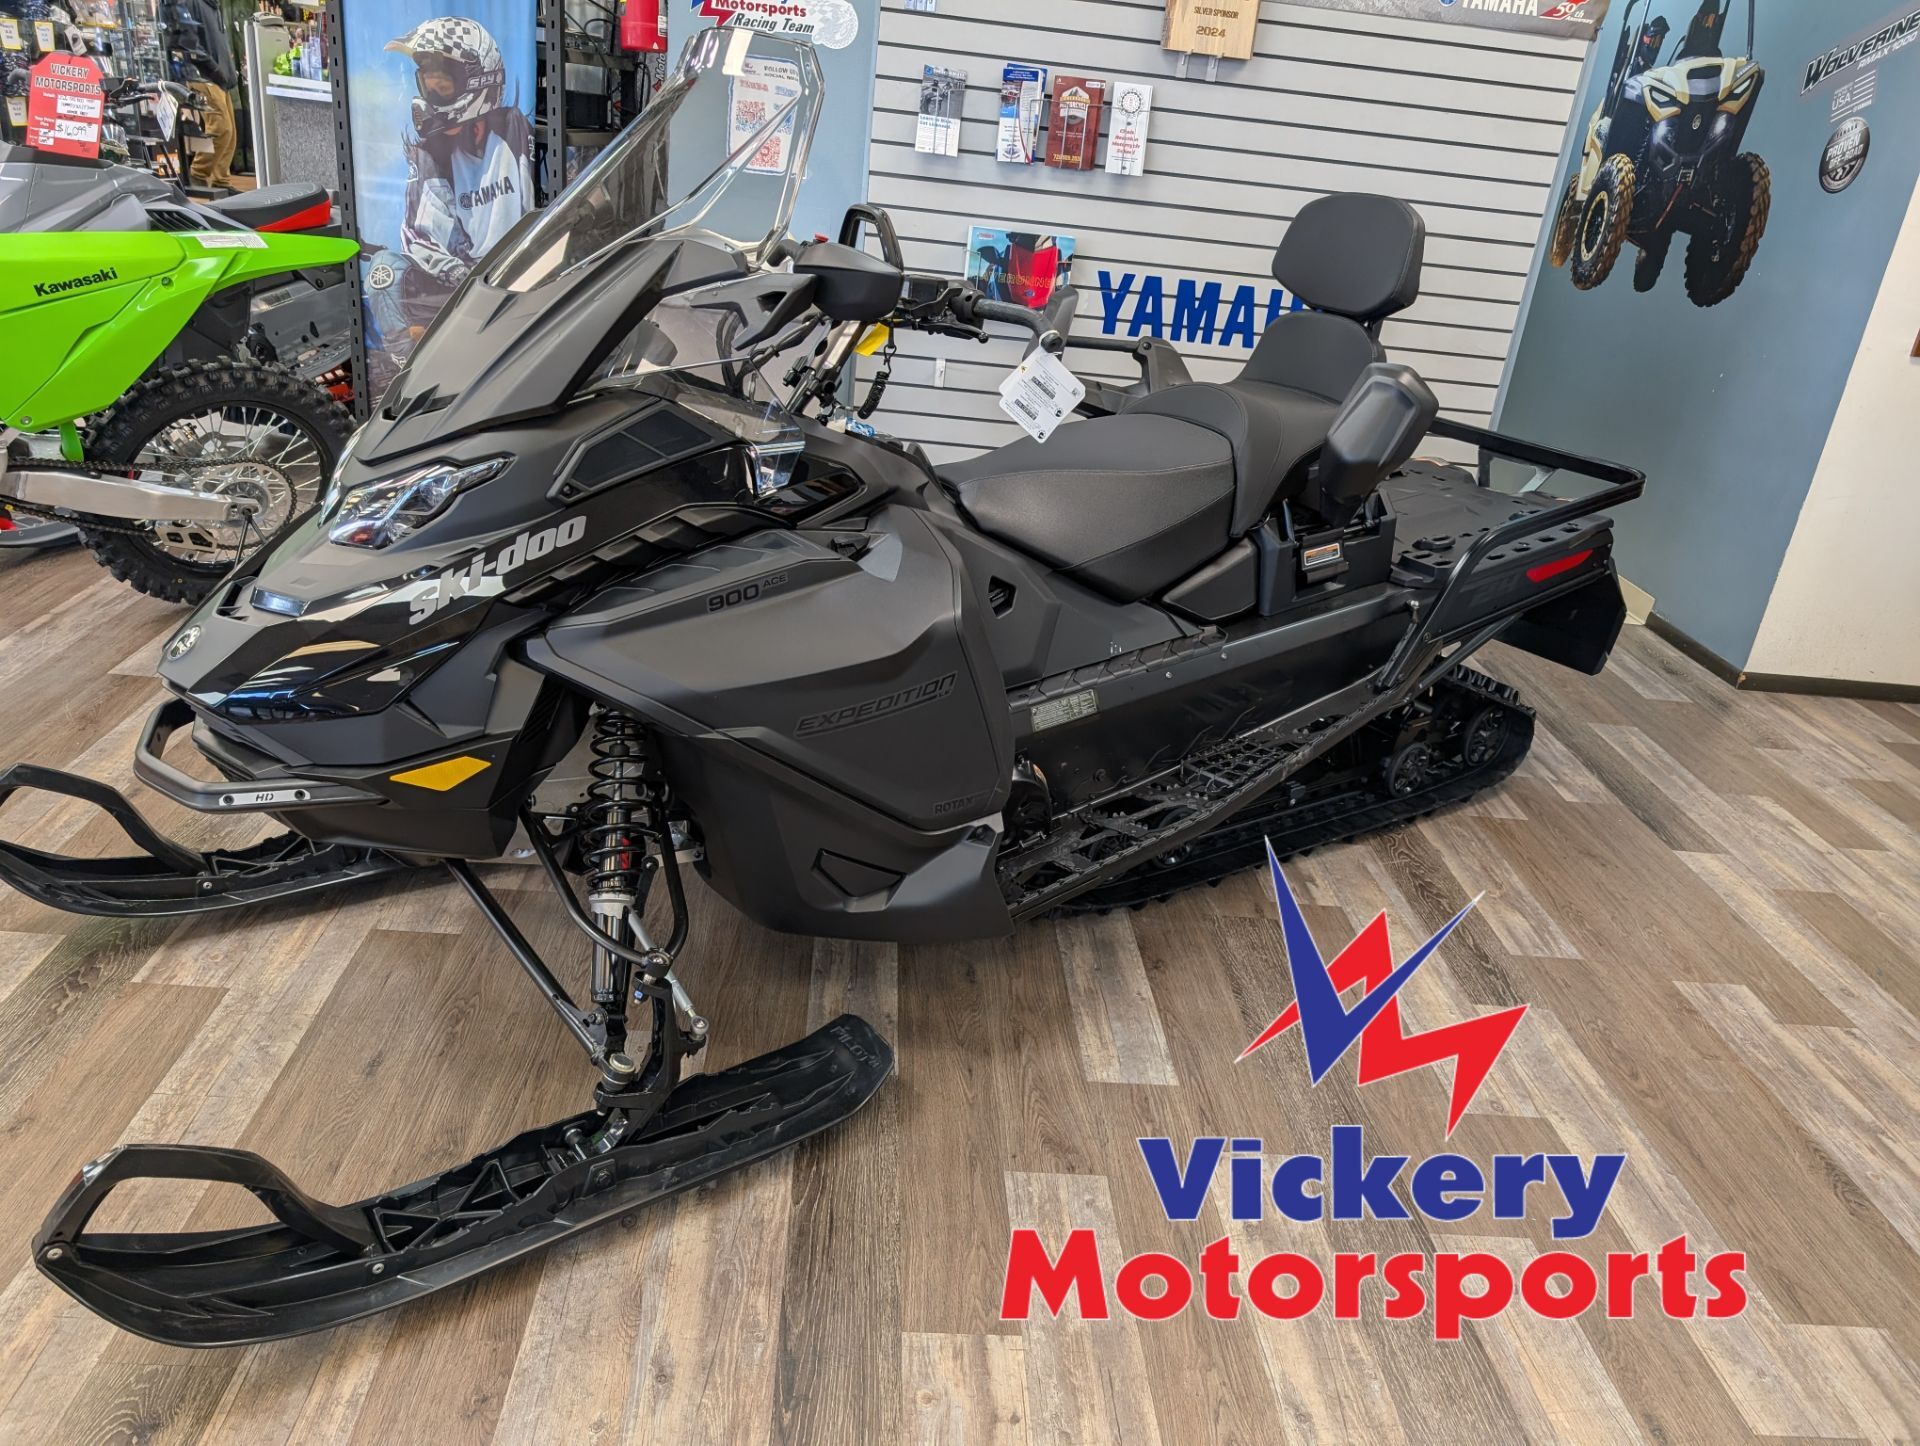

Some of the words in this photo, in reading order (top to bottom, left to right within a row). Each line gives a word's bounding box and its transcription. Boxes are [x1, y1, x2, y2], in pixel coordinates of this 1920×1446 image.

[715, 0, 807, 17] Motorsports
[1193, 6, 1213, 16] SILVER
[1213, 9, 1239, 19] SPONSOR
[733, 13, 778, 31] Racing
[782, 18, 815, 33] Team
[1196, 25, 1226, 38] 2024
[1800, 8, 1920, 95] WOLVERINE
[1857, 46, 1891, 70] RMAX
[1892, 31, 1918, 51] 1000
[51, 63, 90, 78] VICKERY
[35, 76, 101, 94] MOTORSPORTS
[468, 75, 495, 89] SPY
[1832, 92, 1851, 111] USA
[1826, 132, 1861, 161] PROVEN
[1828, 144, 1864, 169] OFF-ROAD
[470, 176, 515, 207] YAMAHA
[33, 267, 118, 297] Kawasaki
[1097, 270, 1304, 349] YAMAH
[707, 584, 760, 612] 900
[797, 672, 958, 732] EXPEDITION
[256, 793, 274, 802] HD
